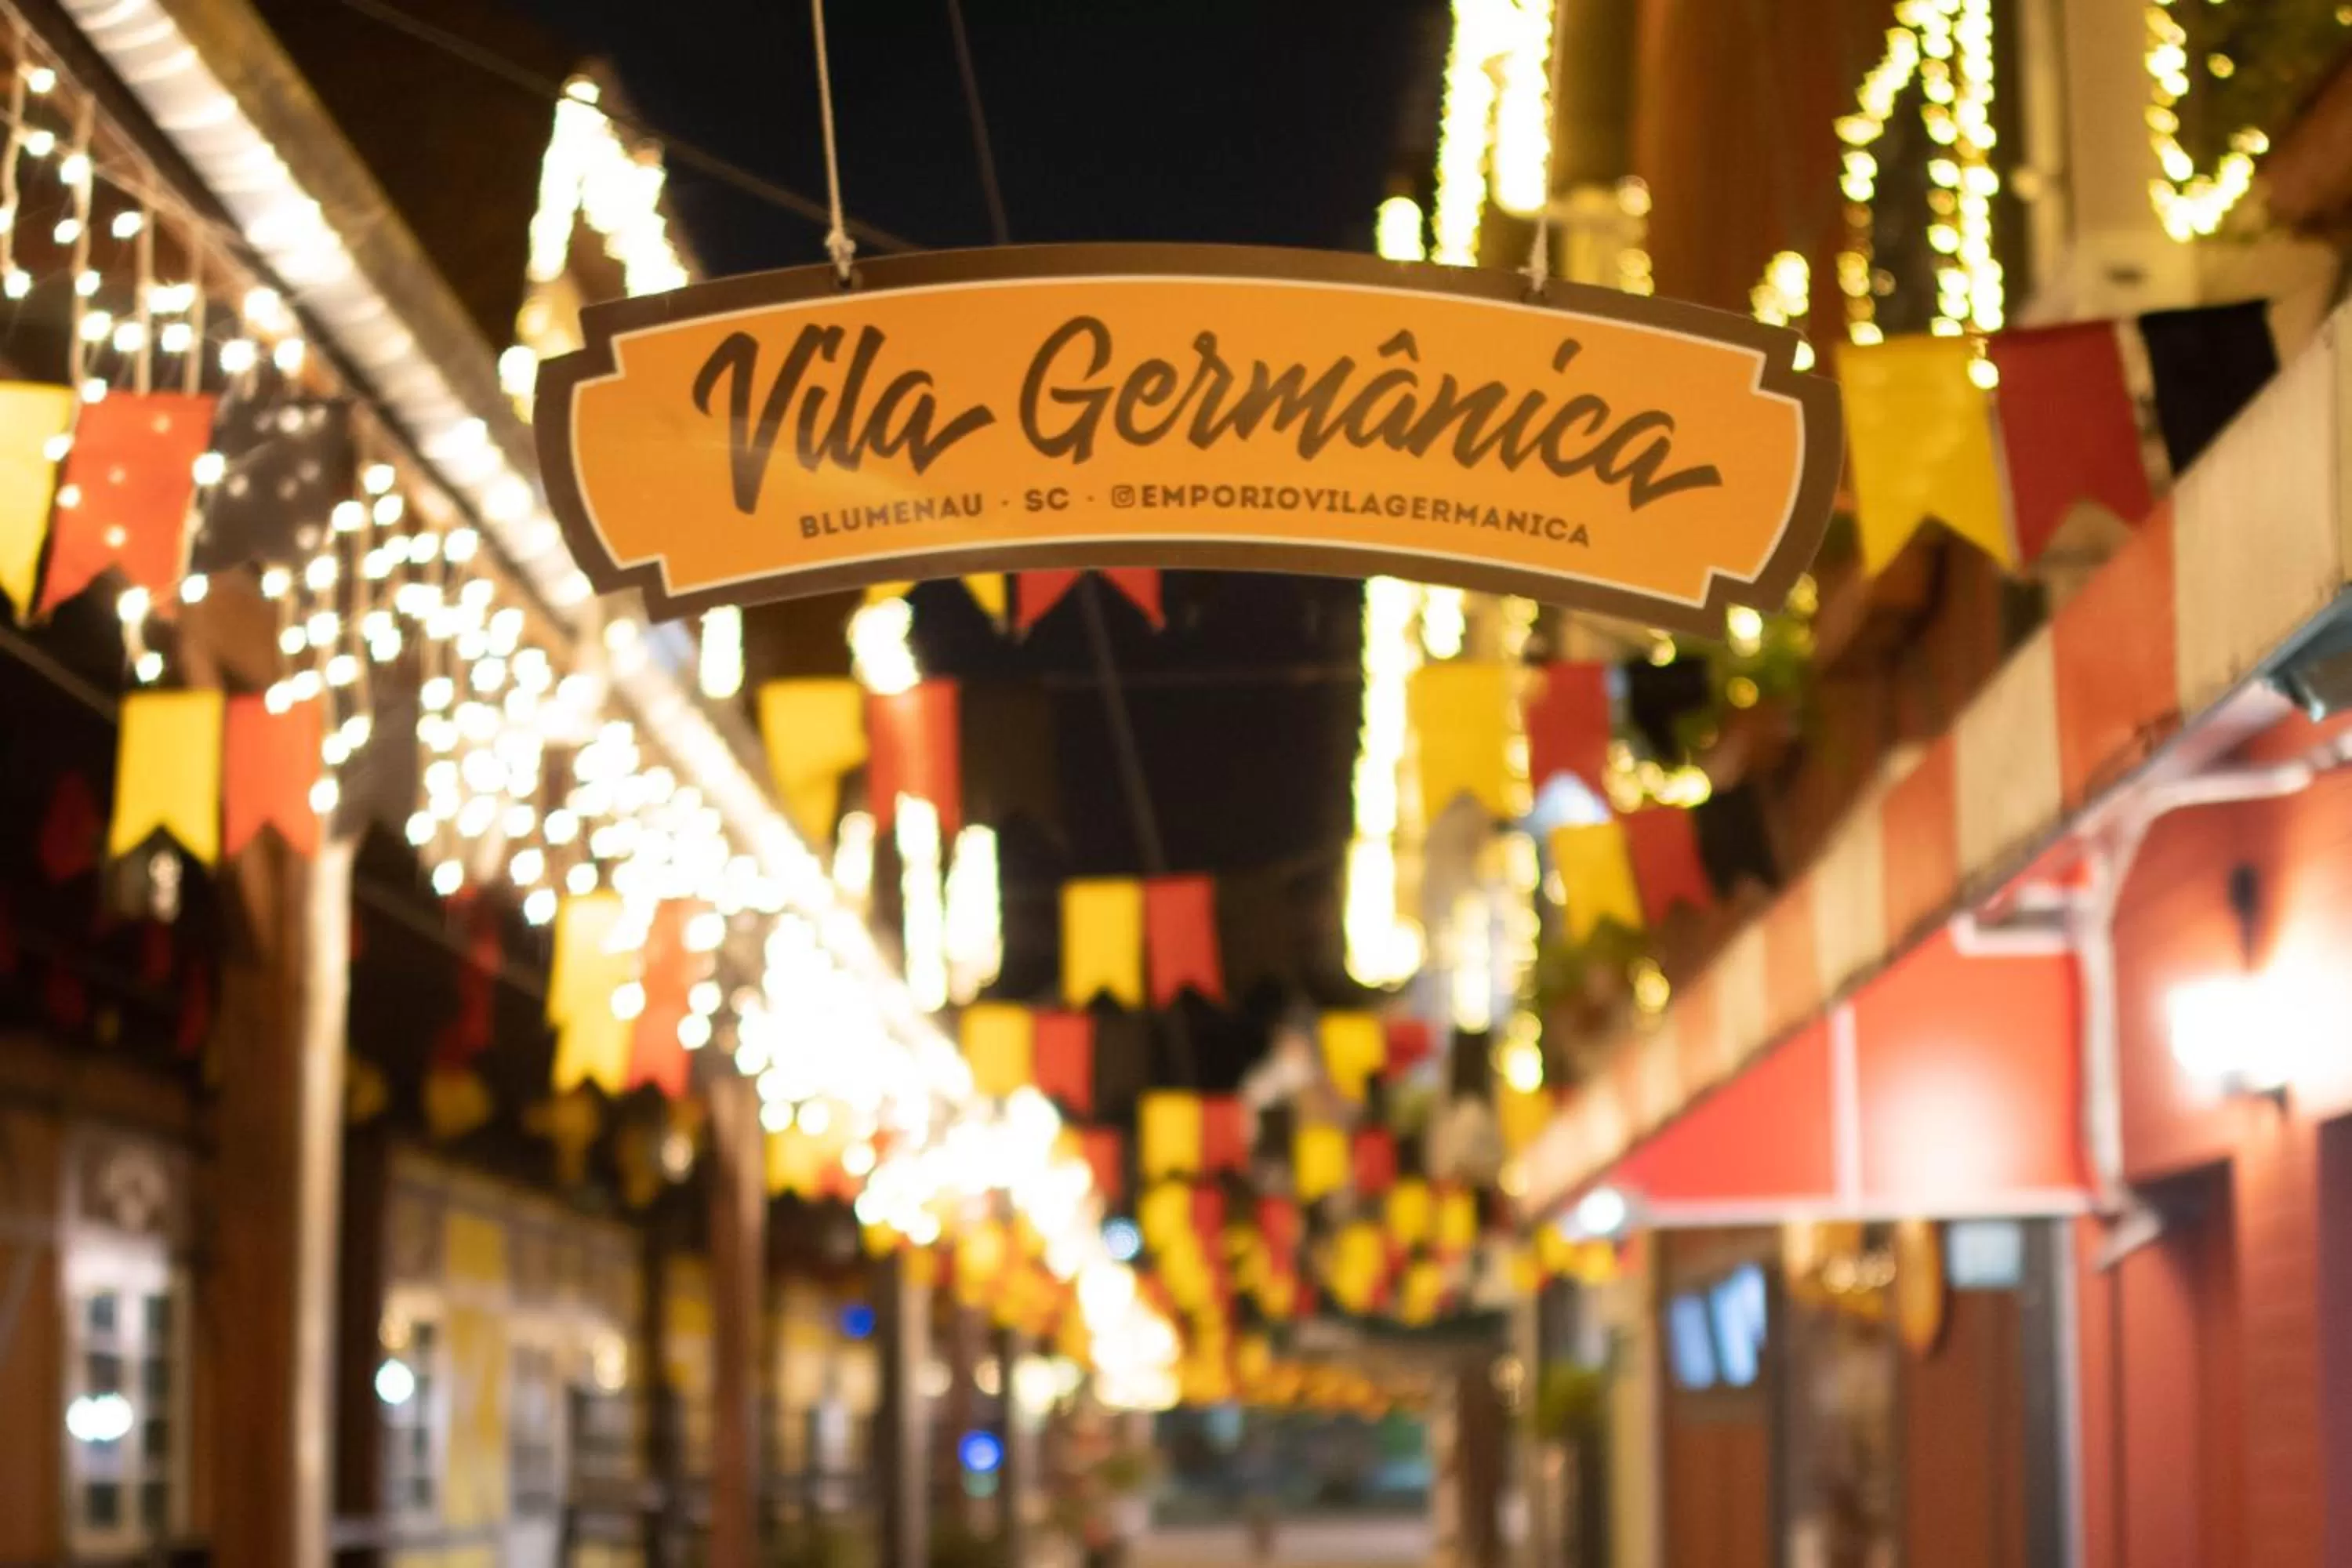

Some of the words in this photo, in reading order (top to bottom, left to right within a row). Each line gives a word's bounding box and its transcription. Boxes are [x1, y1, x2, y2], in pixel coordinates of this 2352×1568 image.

[691, 323, 997, 515] Vila
[1019, 315, 1722, 512] Germânica
[799, 493, 984, 539] BLUMENAU
[1025, 487, 1070, 512] SC
